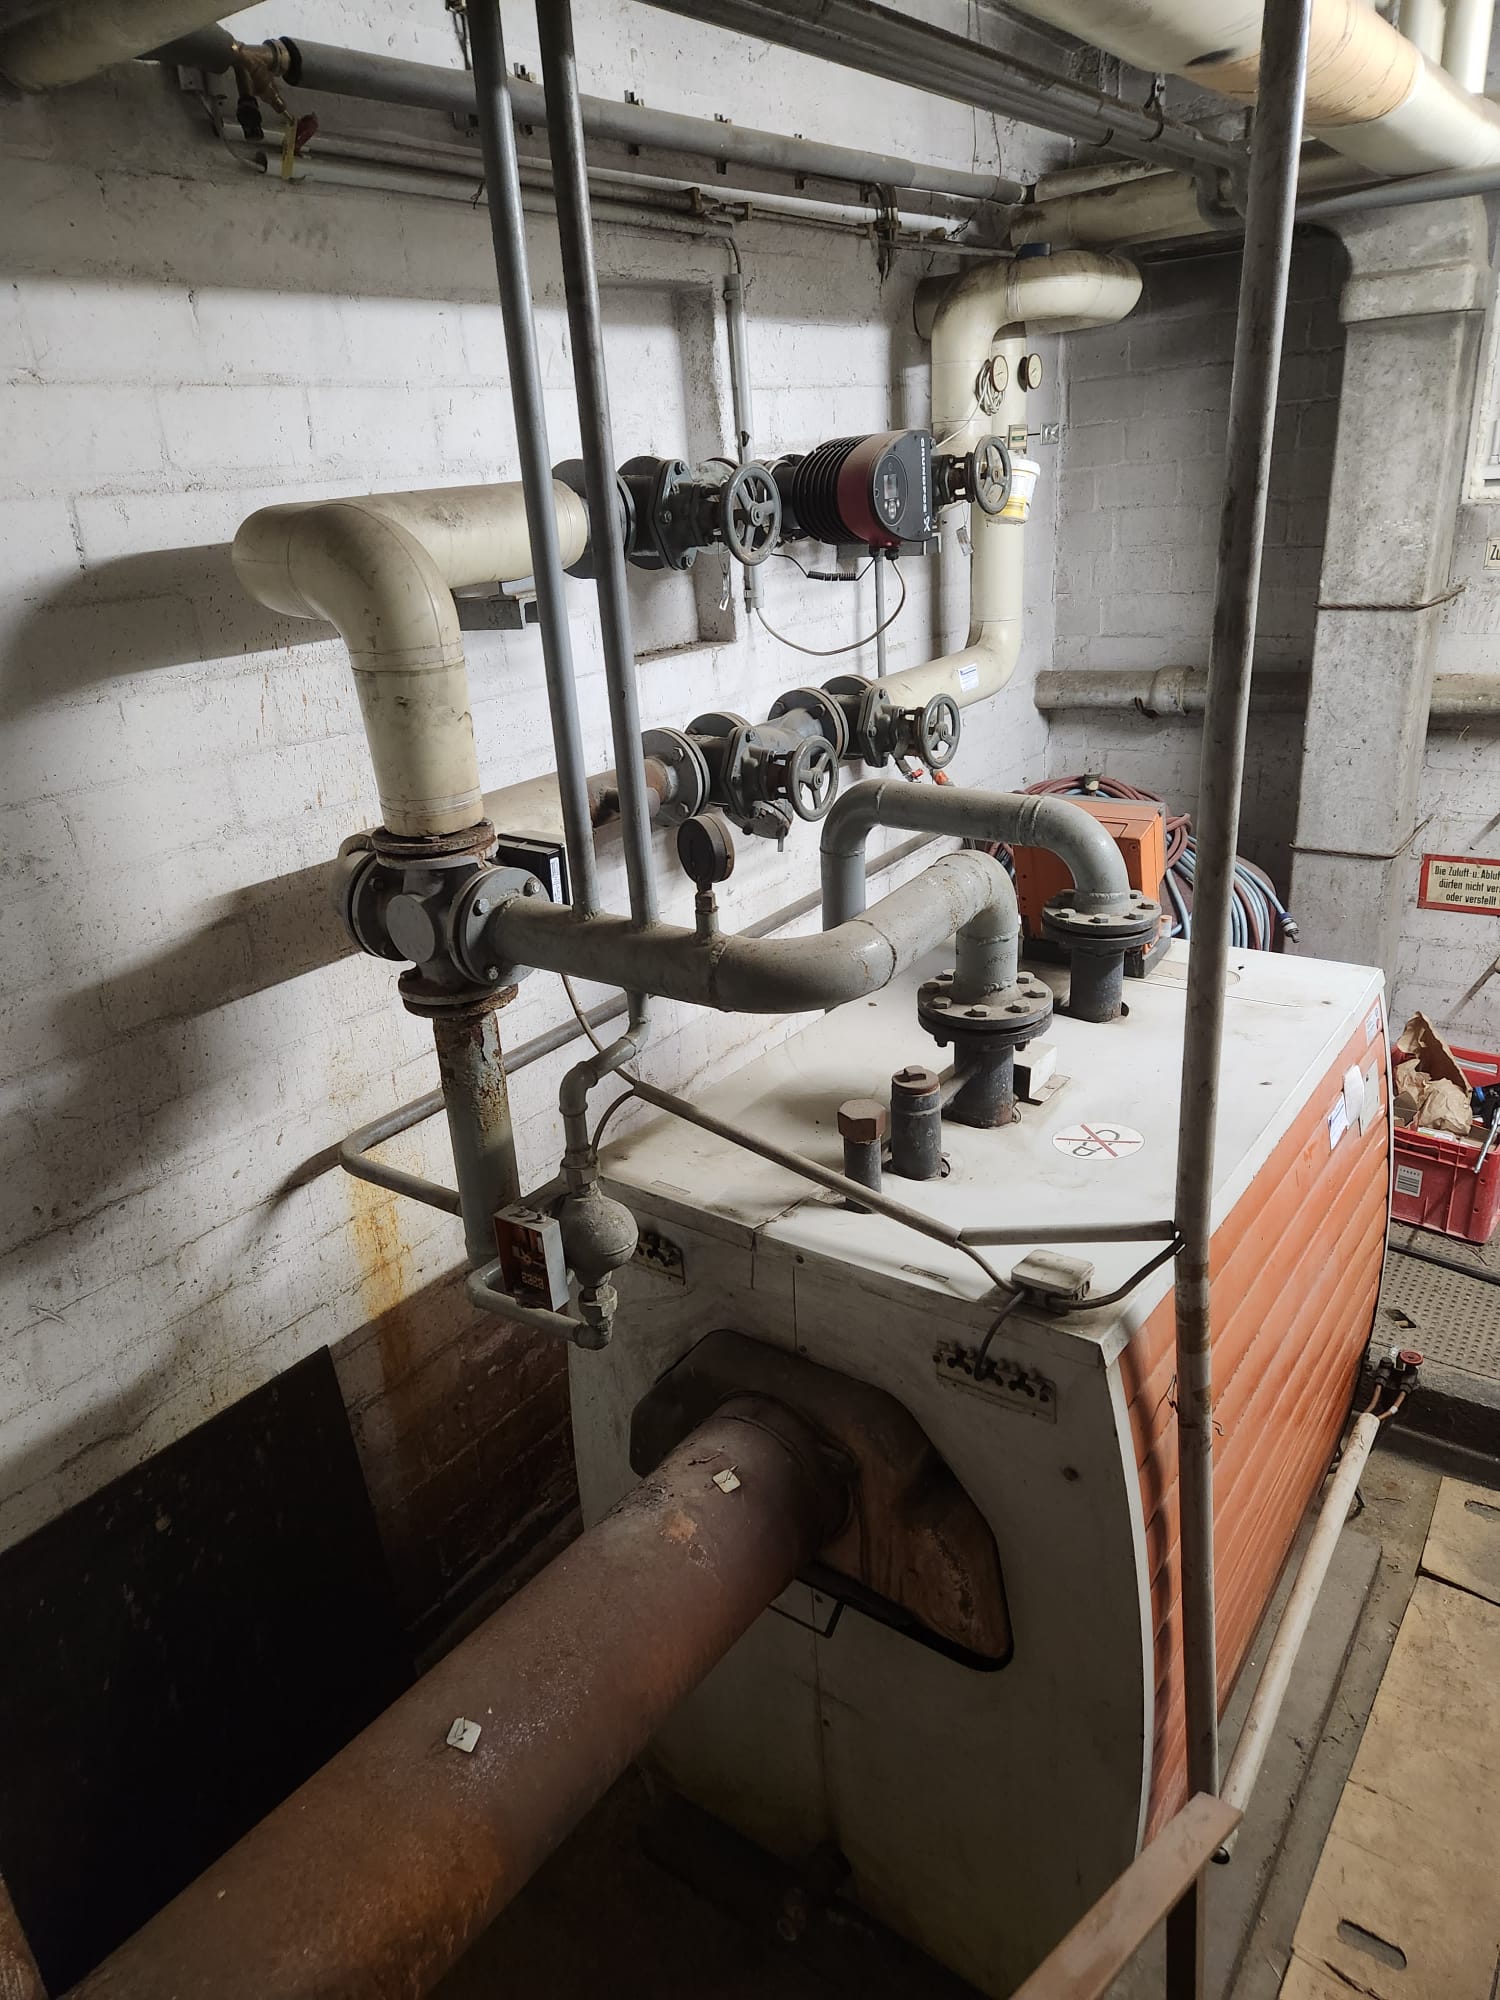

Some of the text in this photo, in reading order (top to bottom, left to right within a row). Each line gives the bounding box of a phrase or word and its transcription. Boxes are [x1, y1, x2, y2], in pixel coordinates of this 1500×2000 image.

[1435, 865, 1446, 875] Die
[1438, 878, 1463, 890] dürfen
[1465, 881, 1484, 892] nicht
[1445, 892, 1497, 906] oder verstellt
